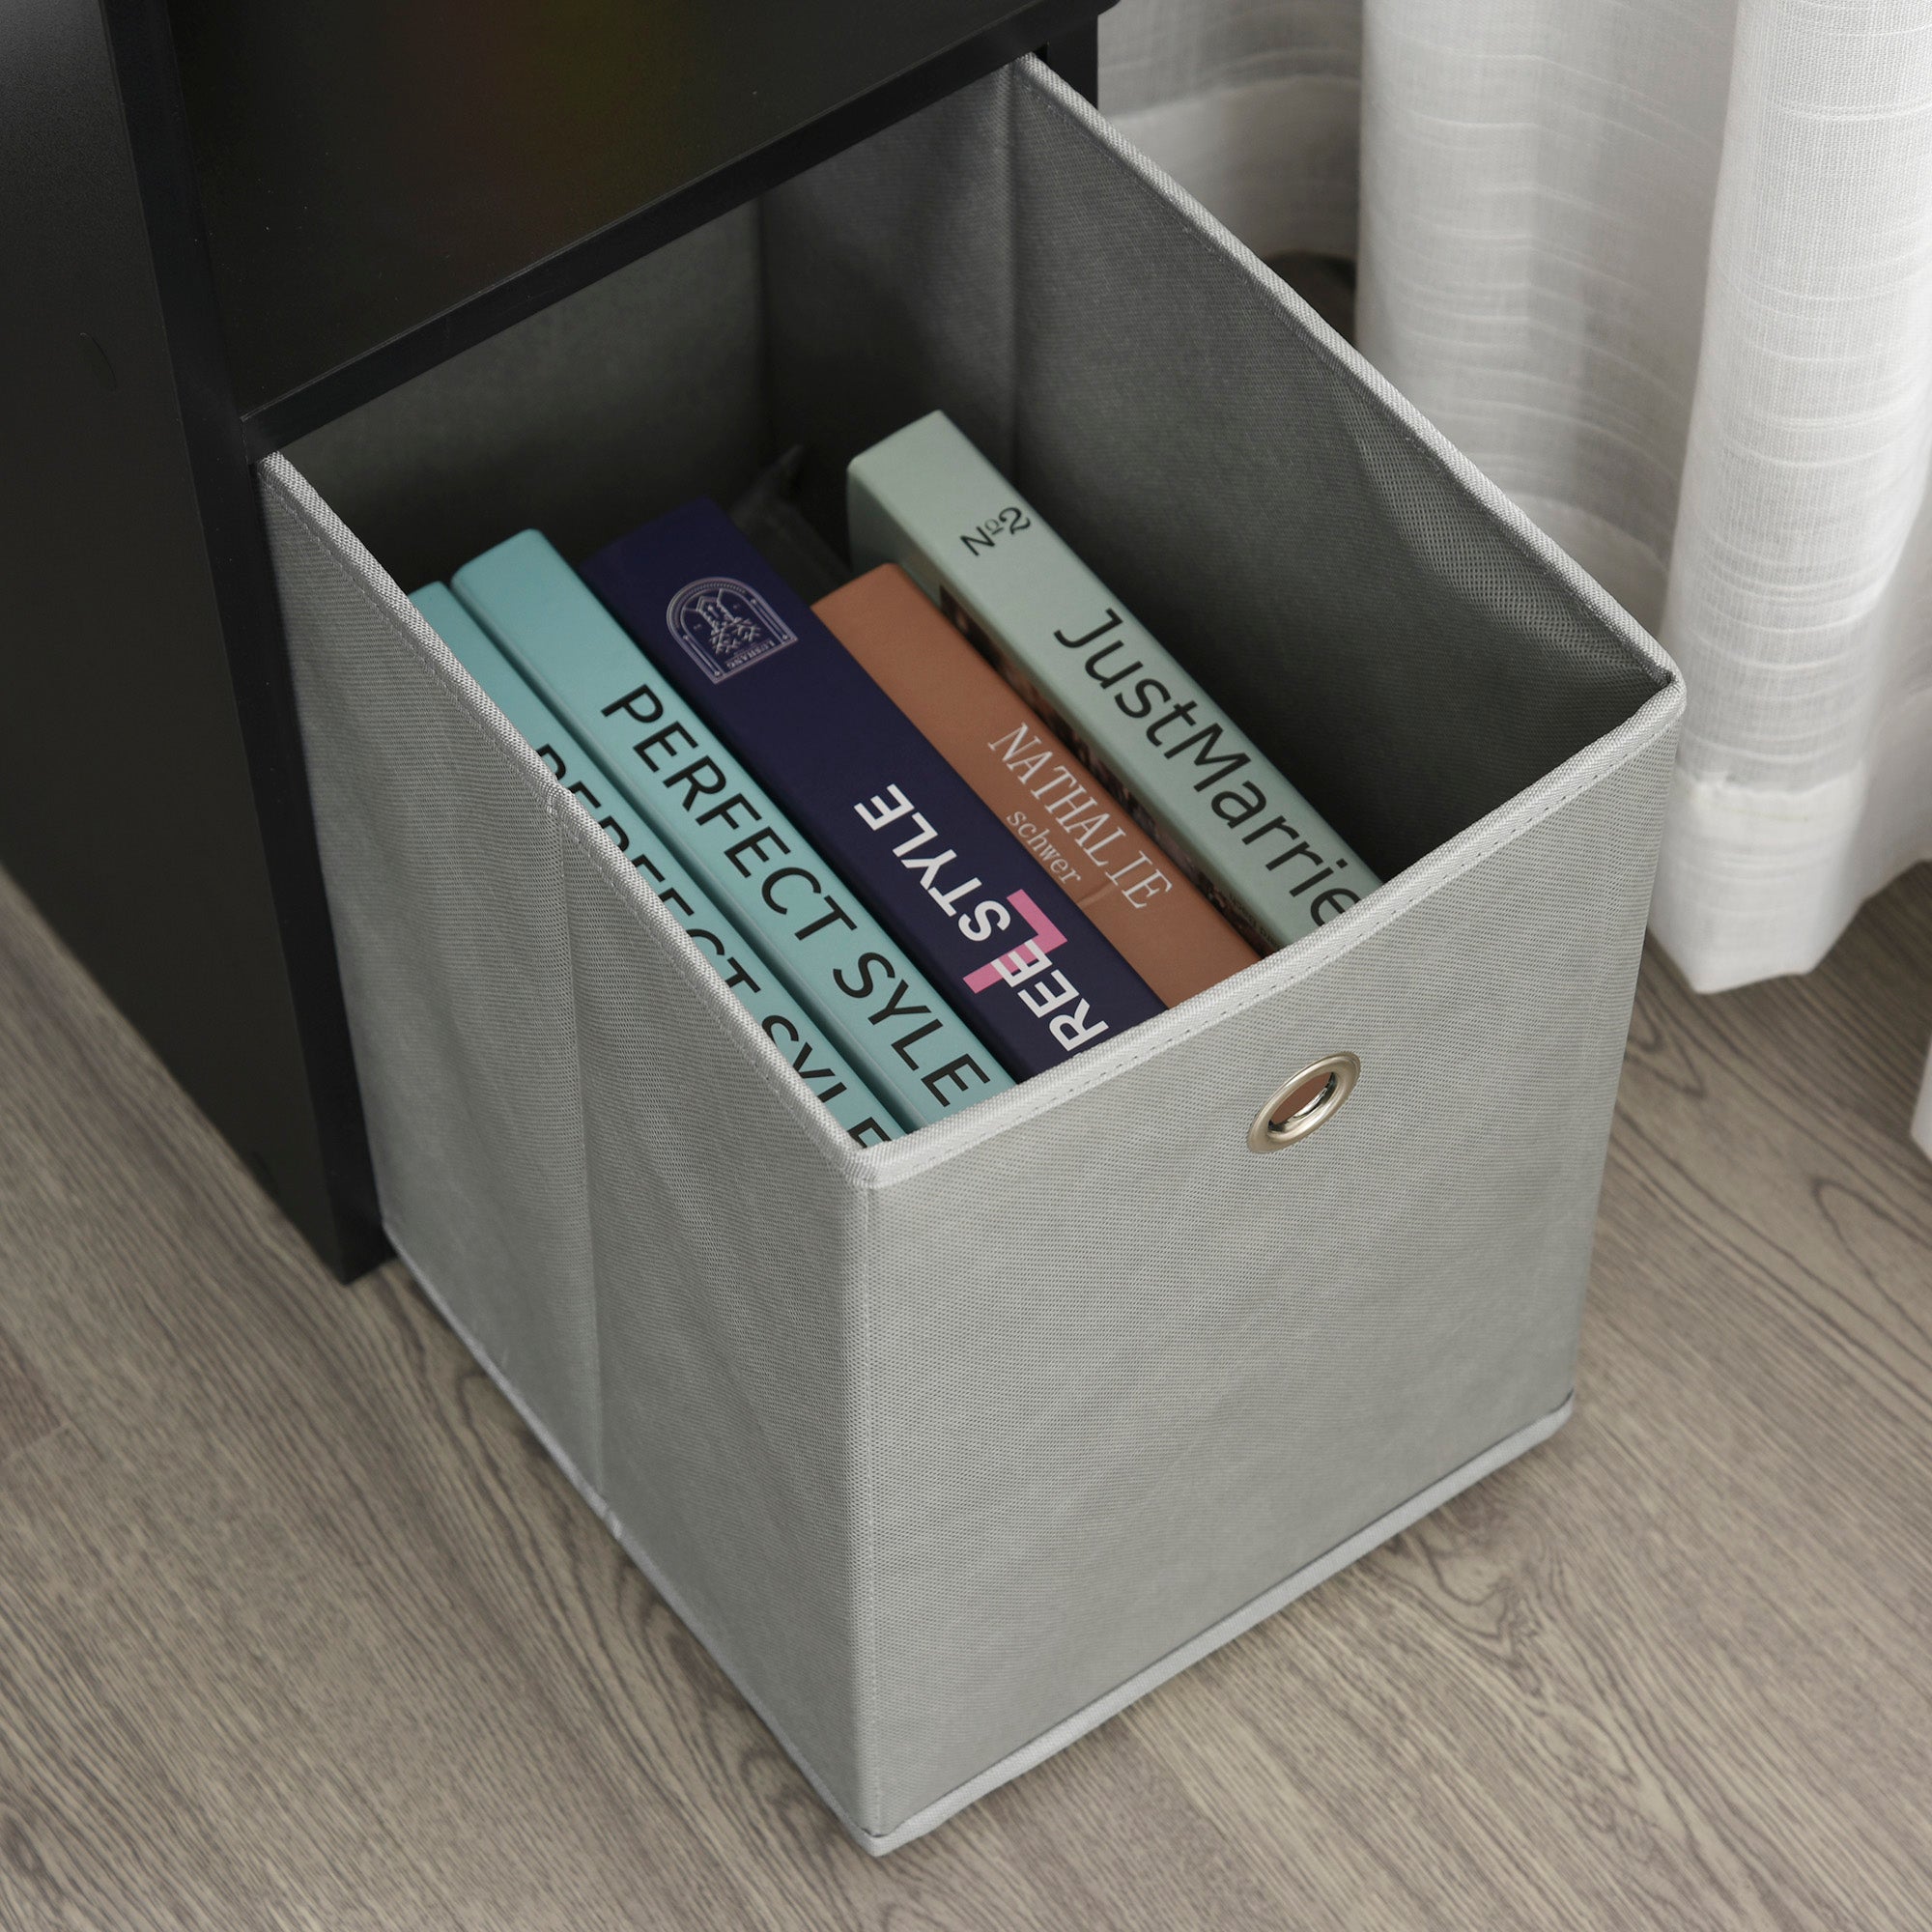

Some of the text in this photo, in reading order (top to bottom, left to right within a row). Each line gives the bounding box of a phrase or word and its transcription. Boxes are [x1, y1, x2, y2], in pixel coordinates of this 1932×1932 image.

[601, 684, 858, 941] PERFECT
[833, 952, 991, 1107] SYLE
[853, 783, 1011, 942] STYLE
[988, 723, 1173, 909] NATHALIE
[1007, 810, 1082, 885] schwer
